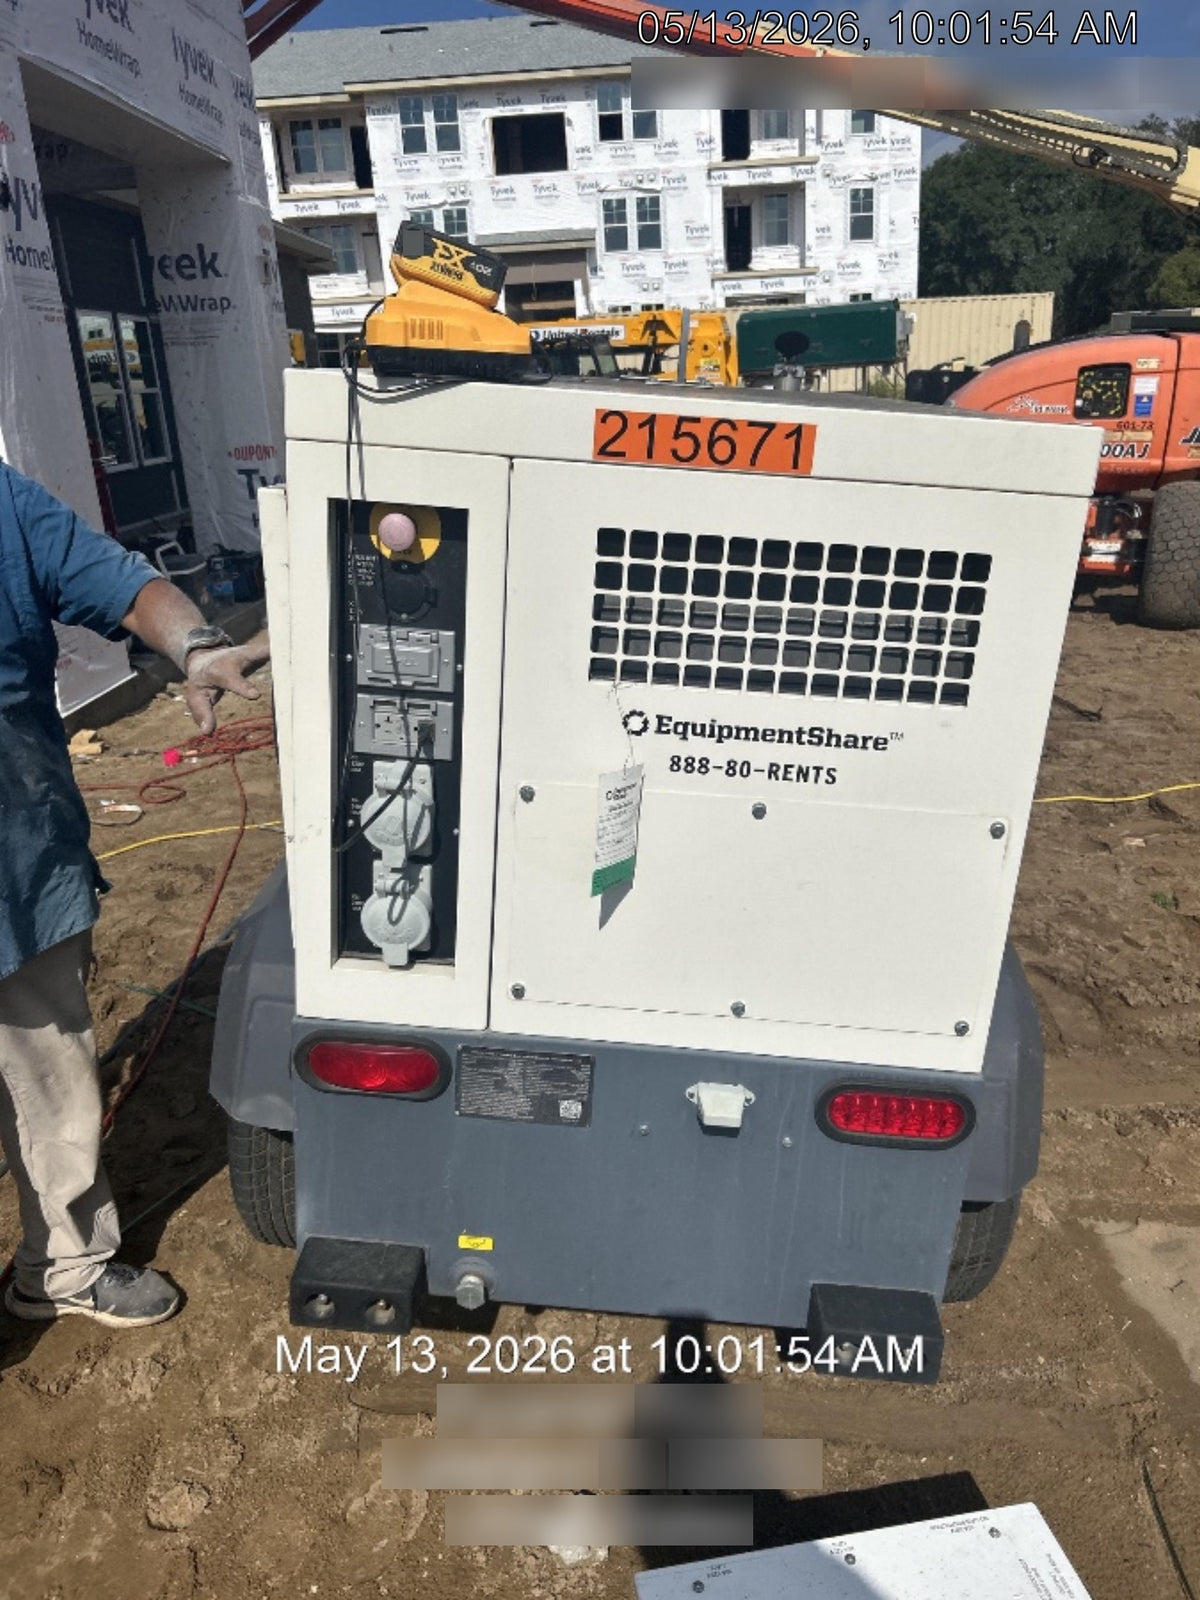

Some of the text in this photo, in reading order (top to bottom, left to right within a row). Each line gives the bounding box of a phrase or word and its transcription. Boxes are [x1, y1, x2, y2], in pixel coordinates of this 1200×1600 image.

[76, 18, 141, 78] HomeWrap
[597, 410, 803, 470] 215671
[669, 755, 838, 786] 888-80-RENTS
